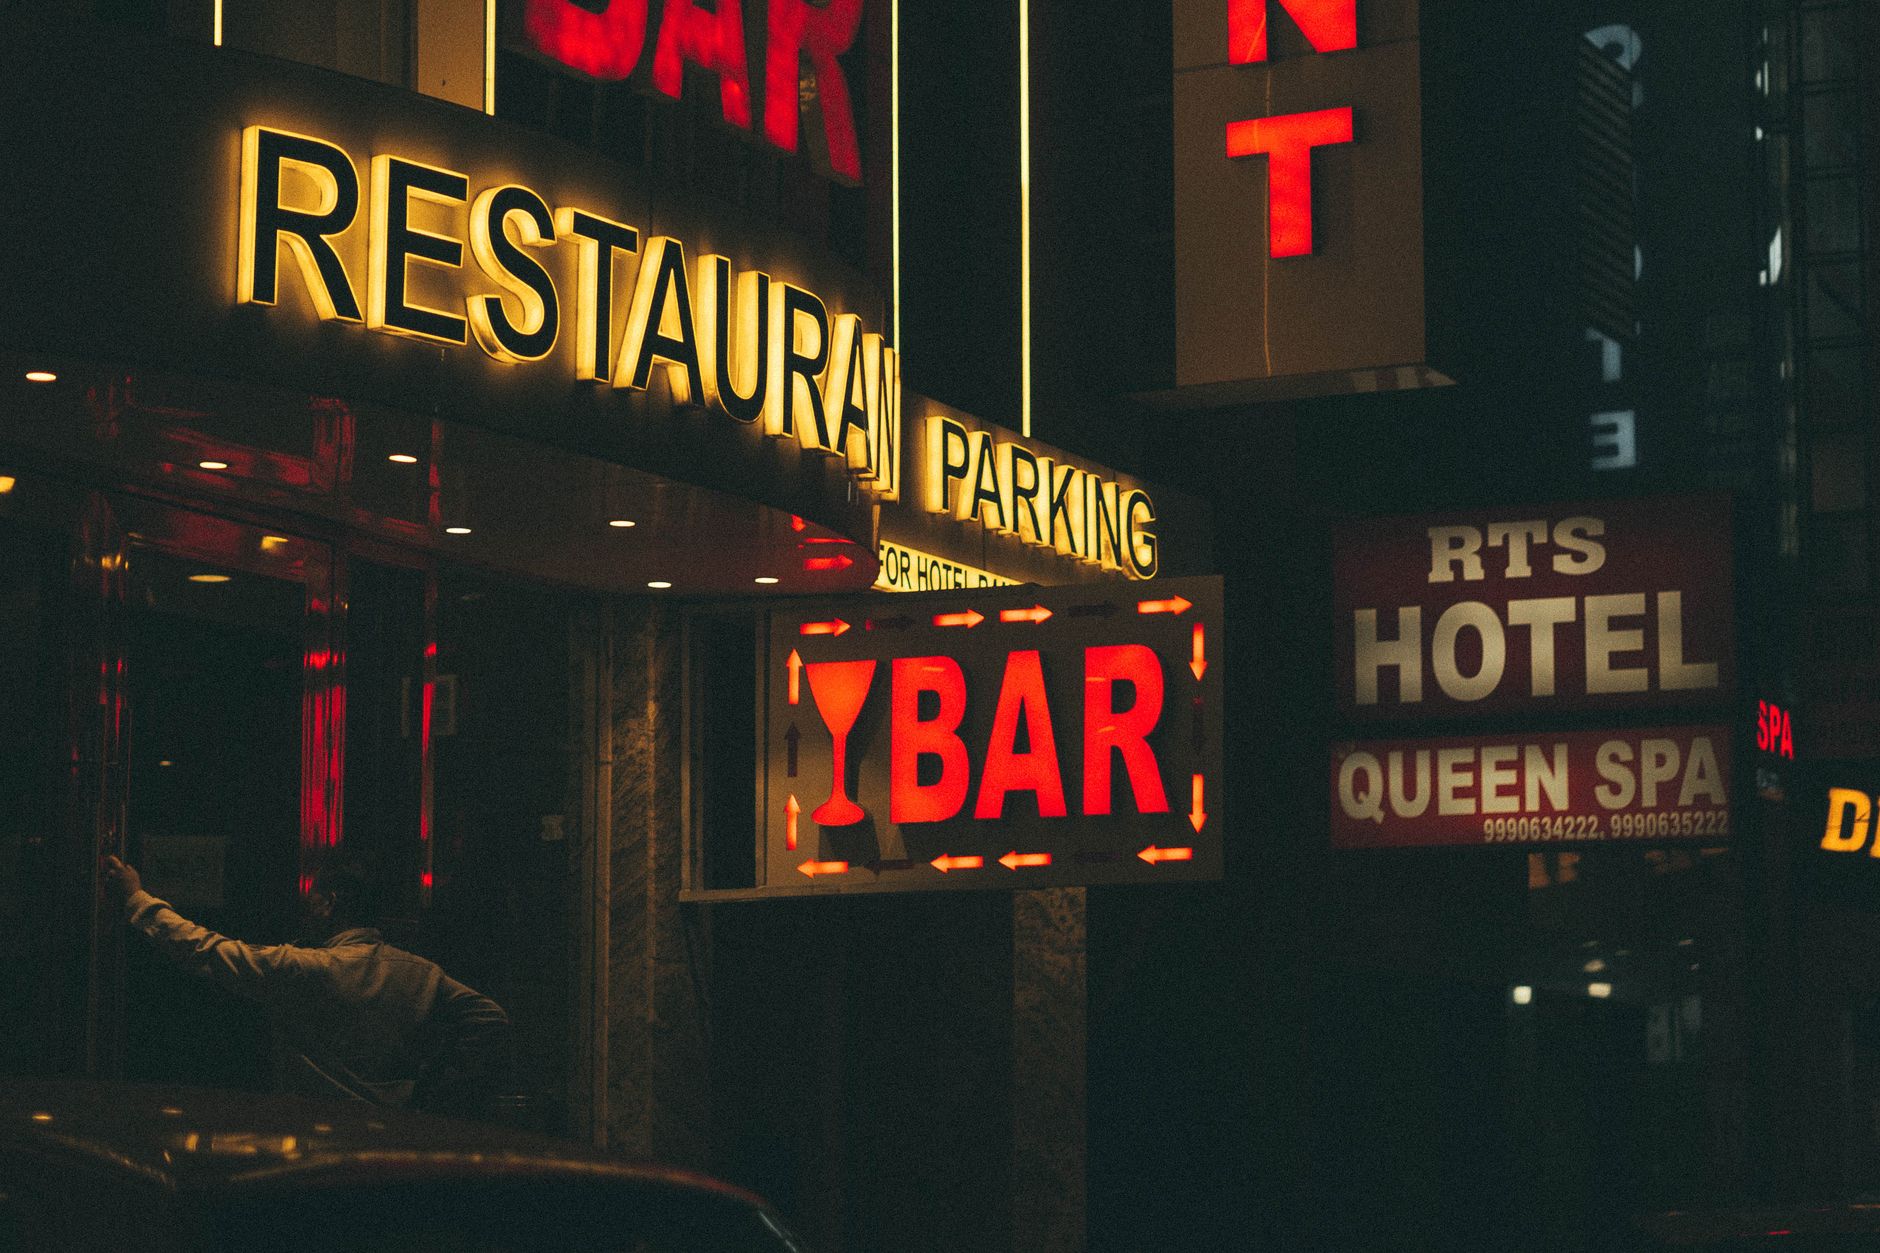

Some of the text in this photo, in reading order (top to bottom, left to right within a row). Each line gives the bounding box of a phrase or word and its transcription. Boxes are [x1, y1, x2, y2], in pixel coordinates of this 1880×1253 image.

[926, 416, 1158, 580] PARKING
[1428, 516, 1607, 583] RTS
[1354, 590, 1719, 705] HOTEL
[890, 644, 1170, 824] BAR
[1757, 699, 1794, 761] SPA
[1338, 743, 1569, 824] QUEEN
[1594, 736, 1727, 809] SPA
[1610, 811, 1729, 838] 9990635222
